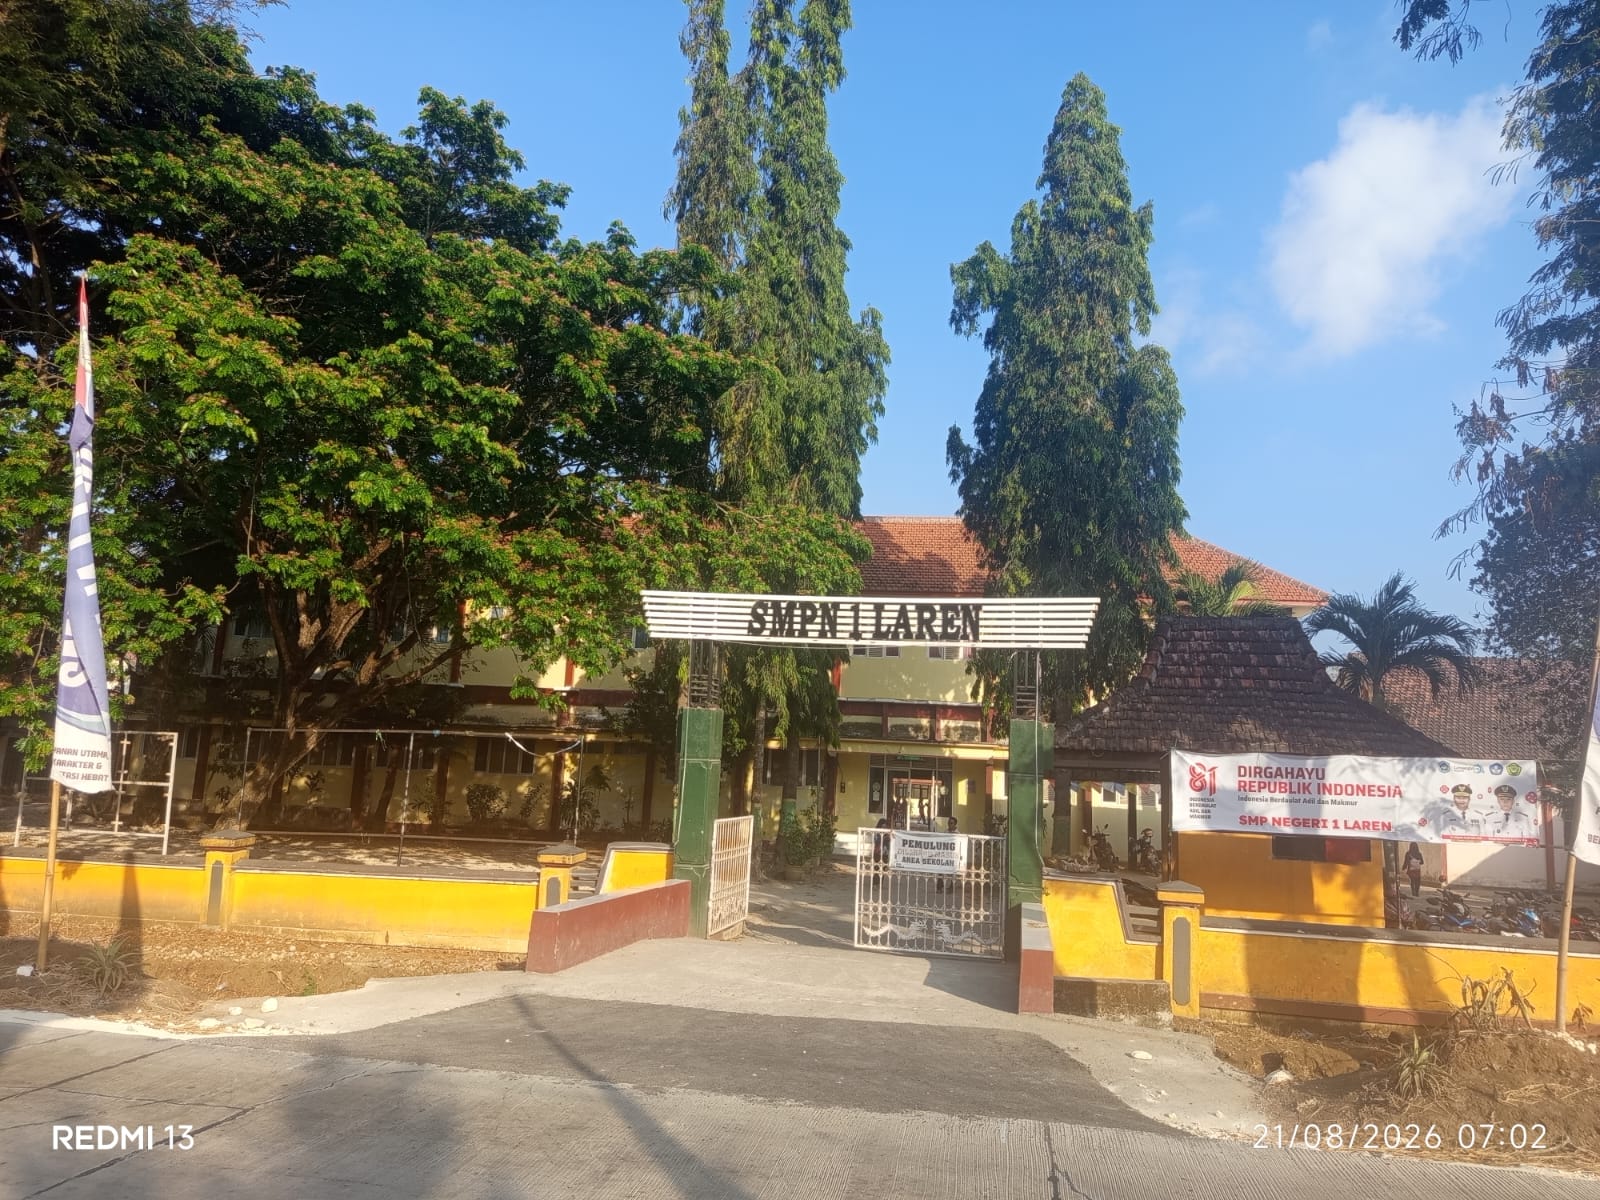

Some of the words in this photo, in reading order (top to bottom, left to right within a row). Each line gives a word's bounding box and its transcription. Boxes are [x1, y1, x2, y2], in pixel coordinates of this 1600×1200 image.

[747, 600, 840, 638] SMPN
[849, 602, 861, 640] 1
[872, 602, 982, 641] LAREN
[81, 773, 109, 782] HEBAT
[1238, 766, 1325, 780] DIRGAHAYU
[1238, 780, 1312, 794] REPUBLIK
[1317, 783, 1403, 798] INDONESIA
[1239, 815, 1268, 825] SMP
[1272, 817, 1328, 828] NEGERI
[1332, 819, 1340, 829] 1
[1344, 820, 1392, 831] LAREN
[902, 839, 955, 850] PEMULUNG
